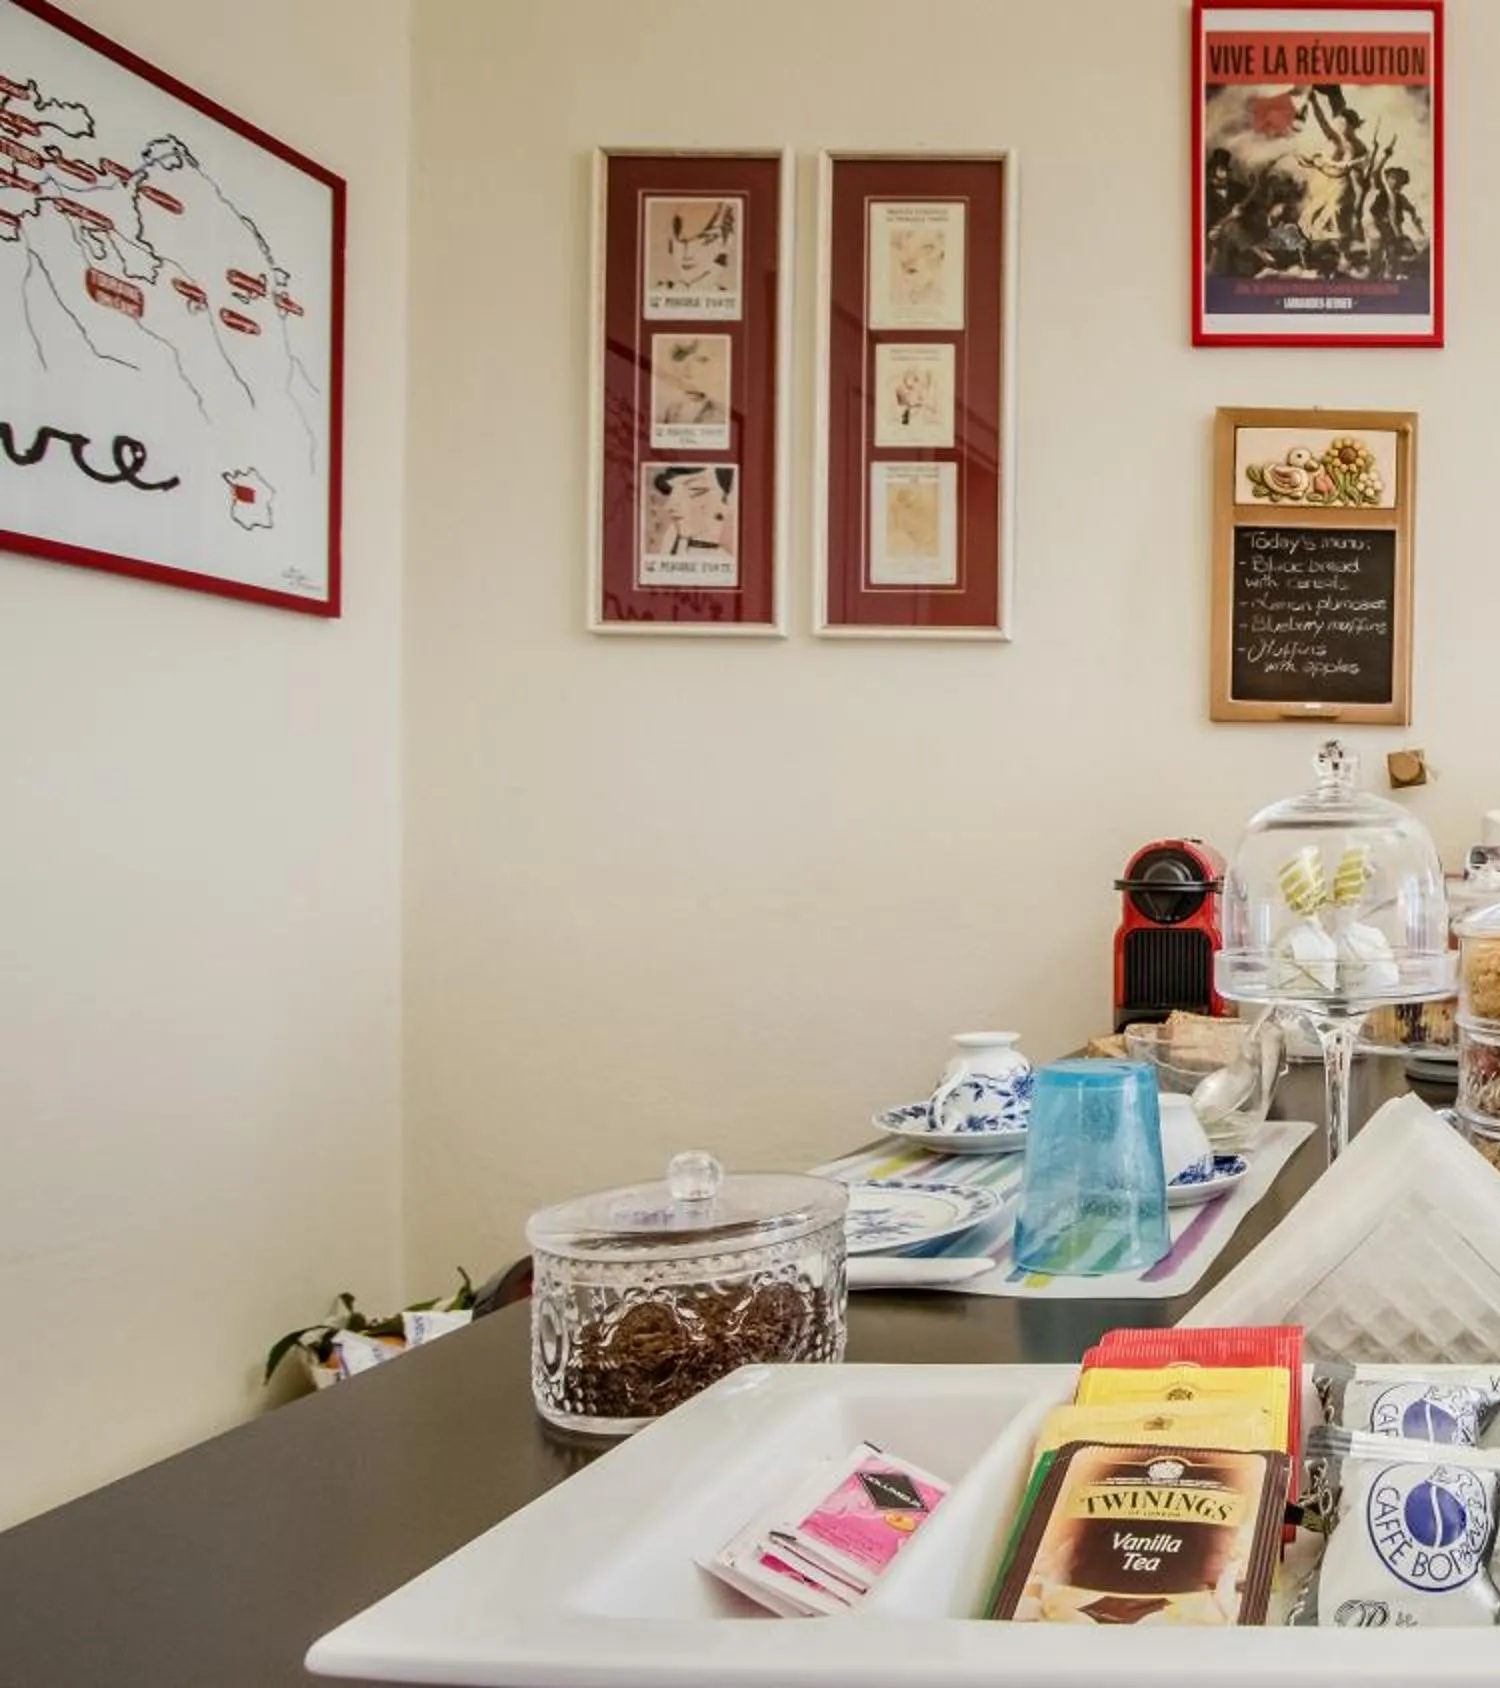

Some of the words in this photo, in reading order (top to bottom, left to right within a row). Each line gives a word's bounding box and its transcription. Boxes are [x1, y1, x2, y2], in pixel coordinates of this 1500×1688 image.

[1209, 45, 1255, 76] VIVE
[1263, 44, 1289, 76] LA
[1295, 38, 1426, 77] RÉVOLUTION
[1244, 573, 1279, 589] with
[1082, 1489, 1236, 1521] TWININGS
[1112, 1530, 1183, 1553] Vanilla
[1122, 1552, 1161, 1572] Tea
